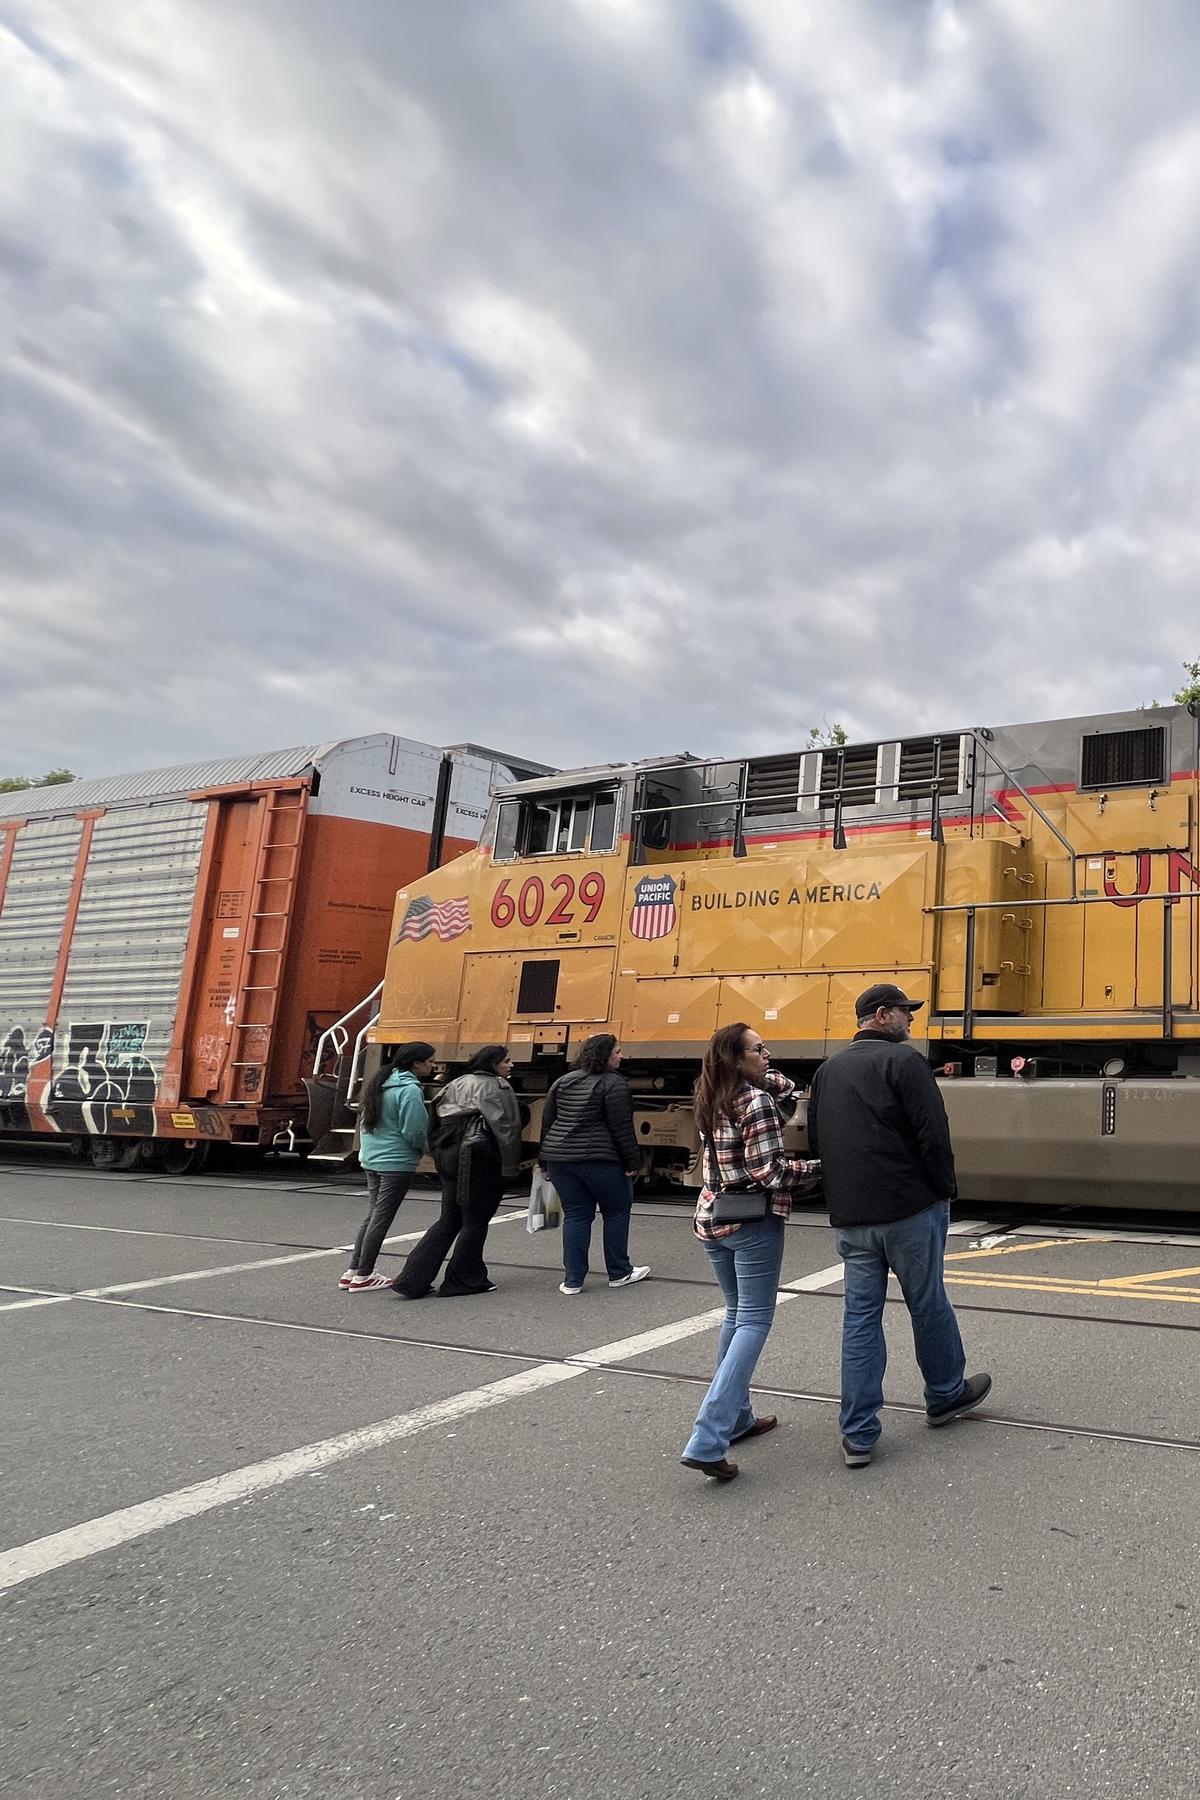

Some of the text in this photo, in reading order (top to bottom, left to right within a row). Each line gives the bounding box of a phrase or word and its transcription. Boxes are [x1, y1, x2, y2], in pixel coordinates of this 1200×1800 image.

[350, 786, 427, 807] EXCESS HEIGHT CAR
[455, 807, 479, 819] EXCESS
[640, 883, 670, 893] UNION
[490, 871, 606, 928] 6029
[638, 891, 671, 903] PACIFIC
[691, 889, 780, 911] BUILDING
